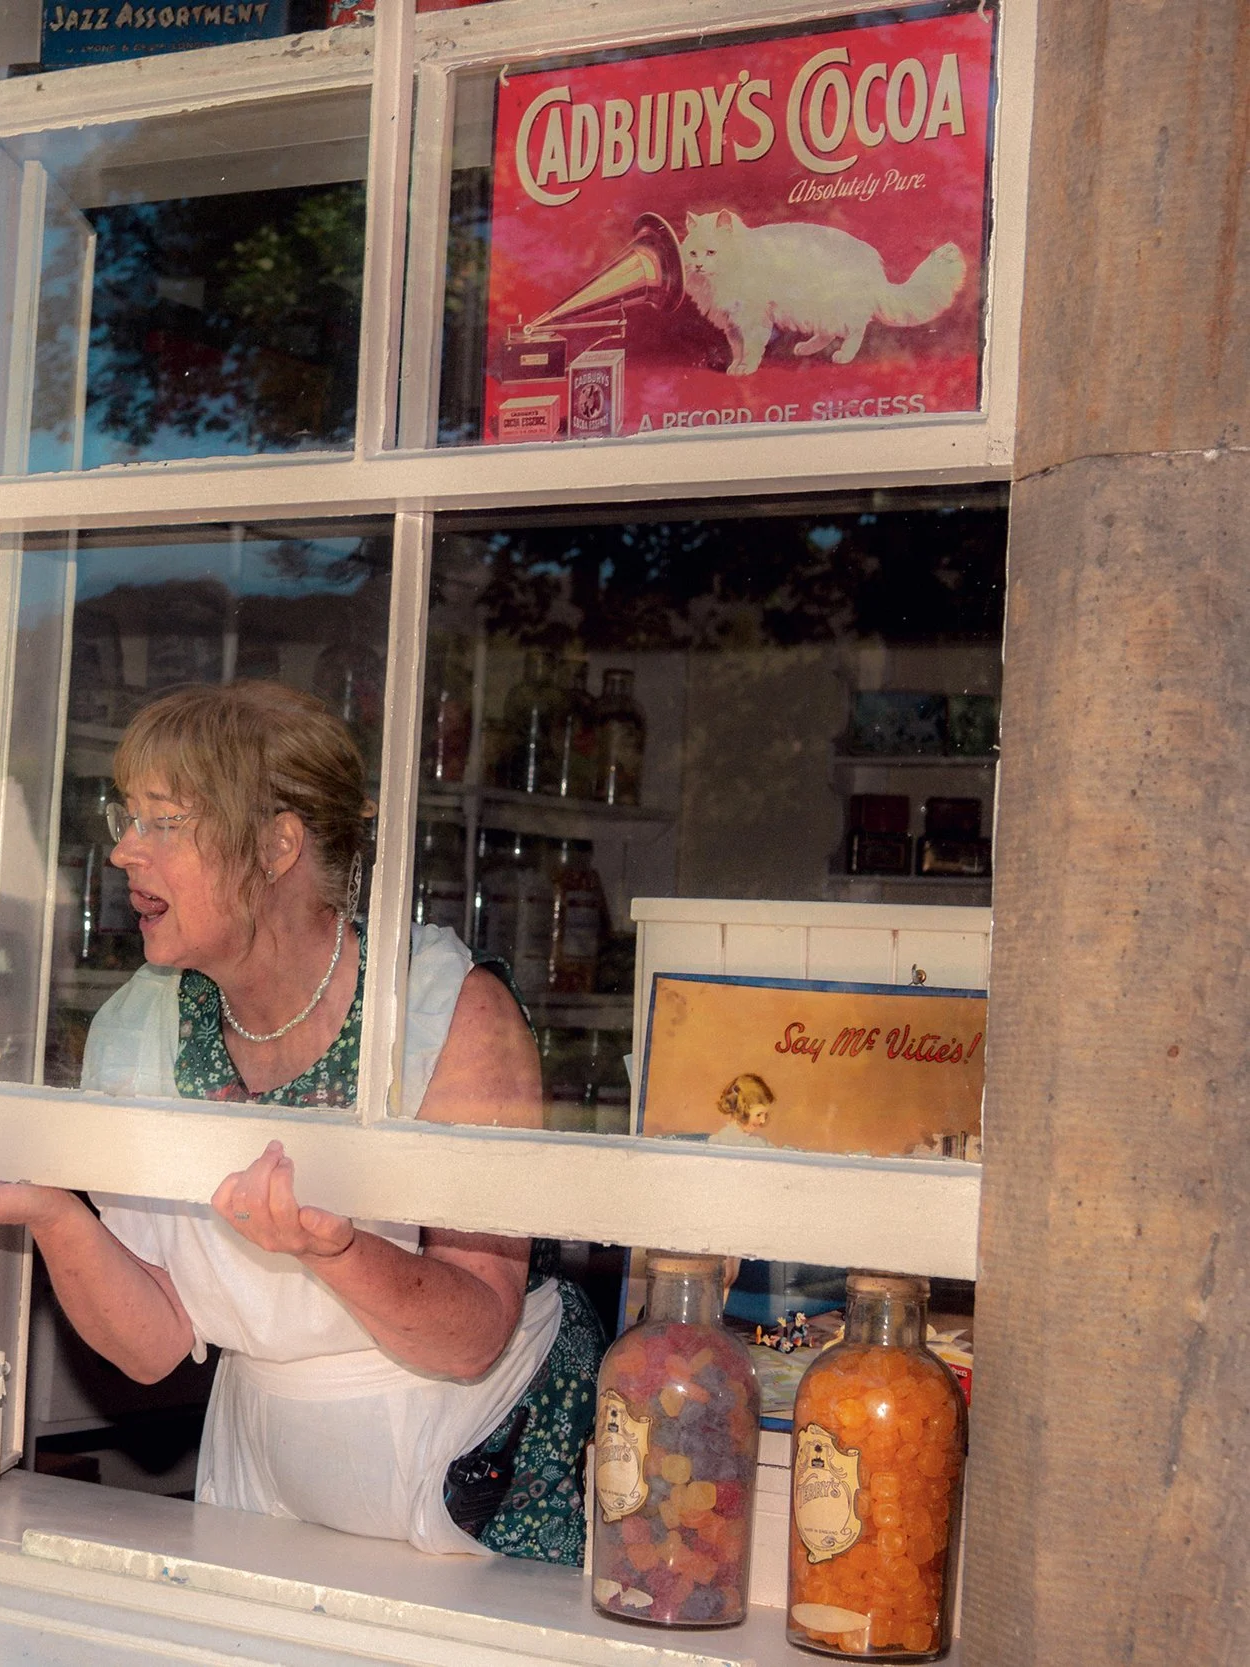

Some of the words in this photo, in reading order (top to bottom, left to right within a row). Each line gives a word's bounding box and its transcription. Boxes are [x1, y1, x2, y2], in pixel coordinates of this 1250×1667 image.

[516, 70, 776, 207] CADBURY'S
[786, 47, 966, 174] COCOA
[788, 172, 881, 204] Absolutely
[883, 168, 926, 193] Pure.
[639, 414, 653, 432] A
[662, 407, 751, 428] RECORD
[765, 404, 799, 423] OF
[812, 394, 926, 422] SUCCESS
[775, 1022, 825, 1063] Say
